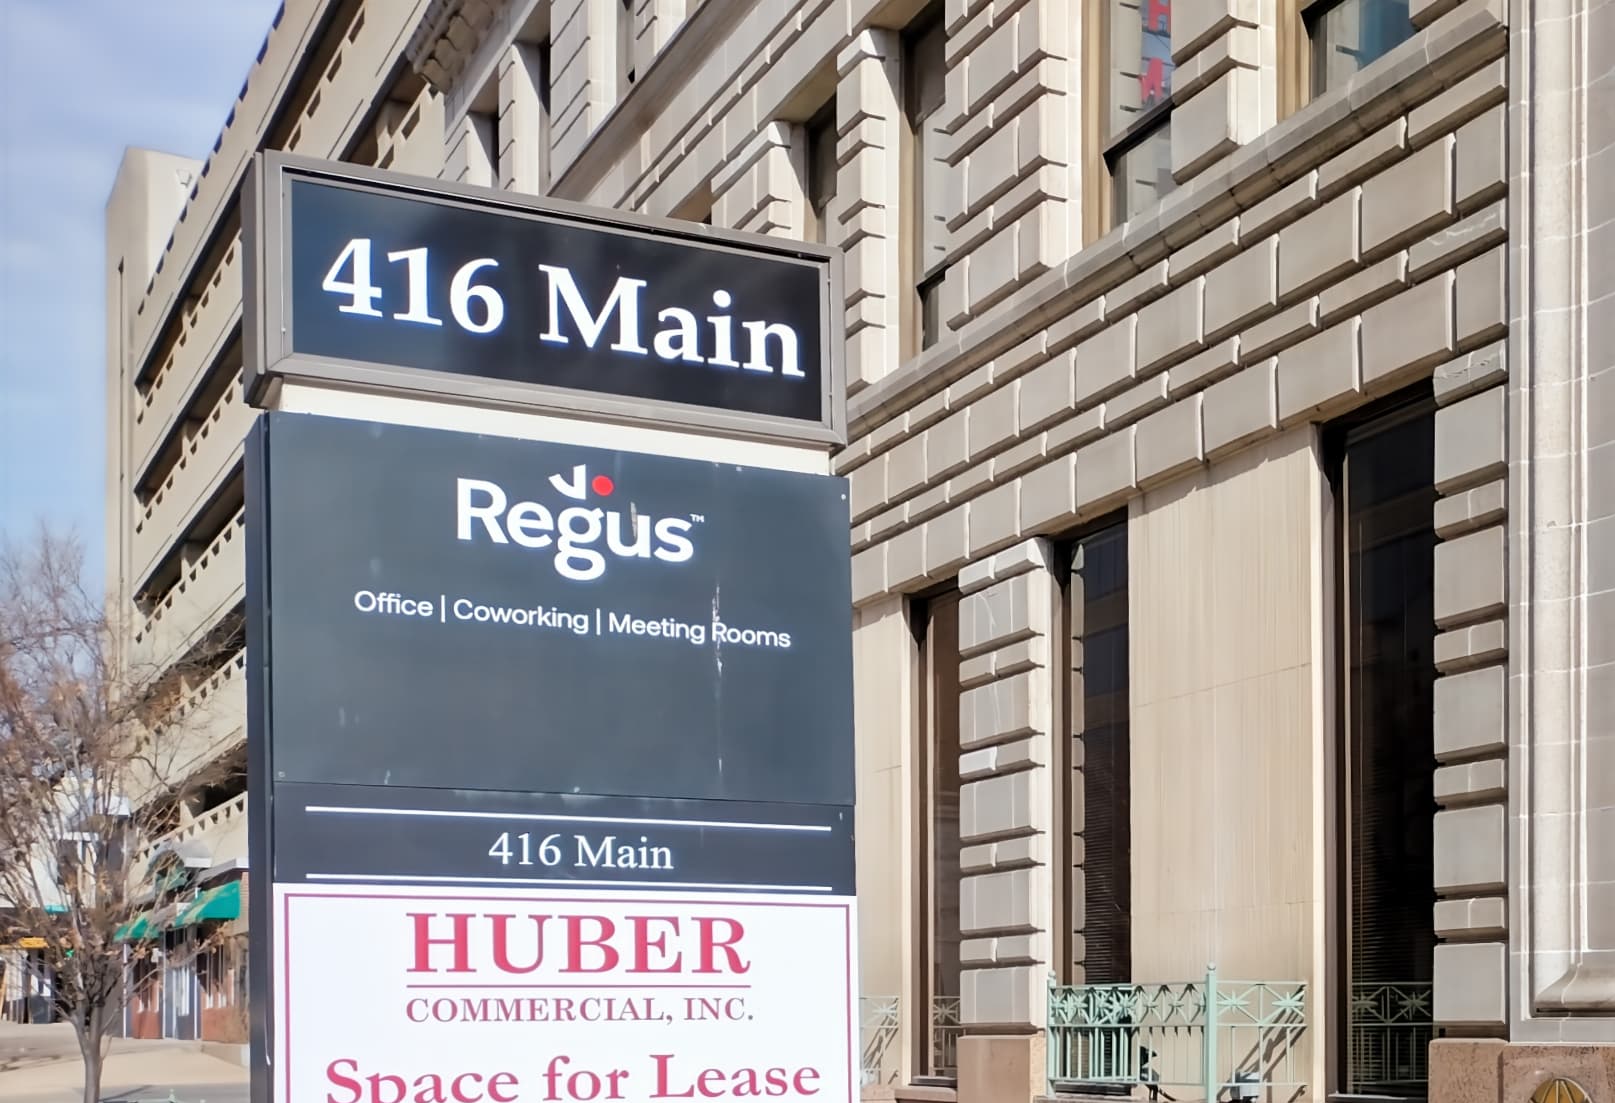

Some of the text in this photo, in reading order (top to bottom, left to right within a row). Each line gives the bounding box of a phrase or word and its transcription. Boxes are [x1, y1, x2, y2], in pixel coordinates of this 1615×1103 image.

[321, 237, 806, 378] 416 Main
[456, 464, 695, 582] Regus
[354, 590, 792, 649] Office Coworking Meeting Rooms
[488, 831, 675, 870] 416 Main
[405, 912, 752, 975] HUBER
[405, 996, 755, 1025] COMMERCIAL, INC.
[542, 1054, 630, 1101] for
[648, 1053, 822, 1099] Lease
